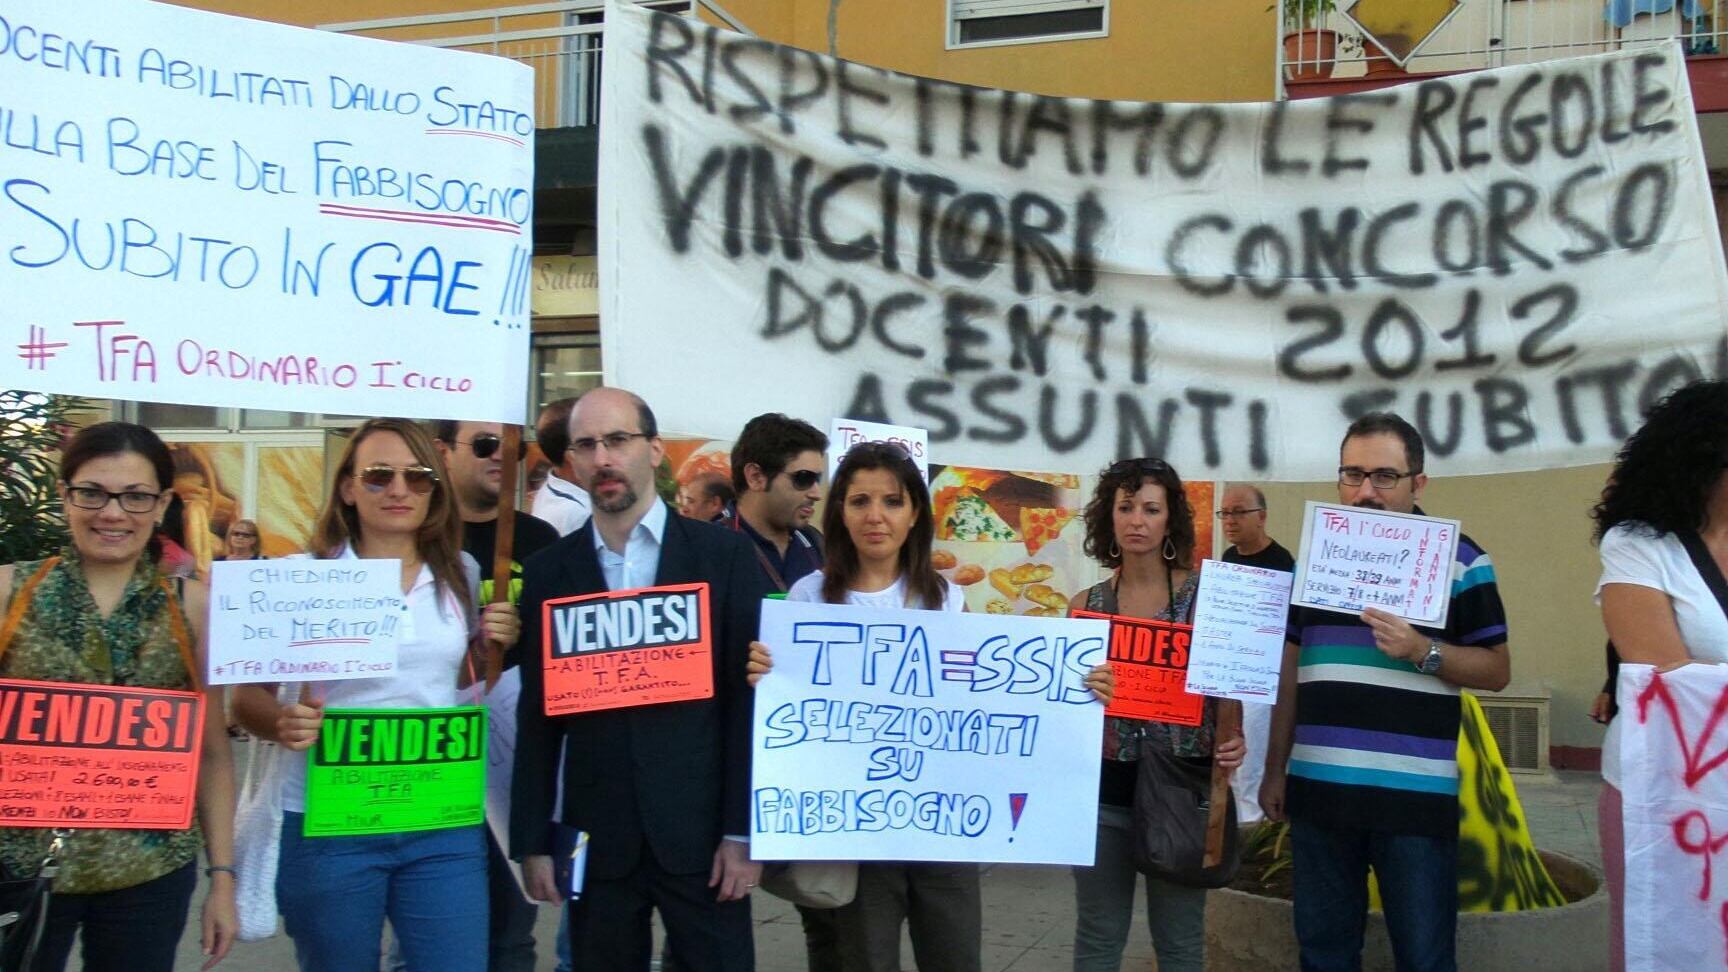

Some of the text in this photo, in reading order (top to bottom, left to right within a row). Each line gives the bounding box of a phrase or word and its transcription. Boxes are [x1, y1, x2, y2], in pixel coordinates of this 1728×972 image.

[138, 47, 313, 109] ABILITATI
[330, 75, 422, 116] DALLO
[426, 86, 534, 138] STATO
[1260, 93, 1399, 178] LE
[1409, 53, 1678, 176] REGOLE
[0, 105, 533, 226] LLA BASE DEL FABBISOGNO
[641, 120, 1676, 300] VINCITORI CONCORSO
[4, 178, 260, 289] SUBITO
[281, 226, 337, 298] IN
[760, 266, 1580, 385] DOCENTI 2012
[176, 338, 358, 390] ORDINARIO
[842, 371, 1270, 472] ASSUNTI
[1323, 512, 1351, 535] TFA
[1371, 522, 1412, 541] CICLO
[219, 590, 400, 614] IL RICONOSCIMENTO
[249, 568, 369, 585] CHIEDIAMO
[242, 624, 281, 641] DEL
[553, 594, 700, 655] VENDESI
[269, 659, 341, 675] ORDINARIO
[559, 648, 686, 674] ABILITAZIONE
[0, 690, 191, 749] VENDESI
[322, 716, 480, 763] VENDESI
[764, 698, 1040, 757] SELEZIONATI
[332, 768, 442, 785] ABILITAZIONE
[866, 746, 925, 782] SU
[367, 783, 414, 799] TFA
[755, 787, 992, 838] FABBISOGNO
